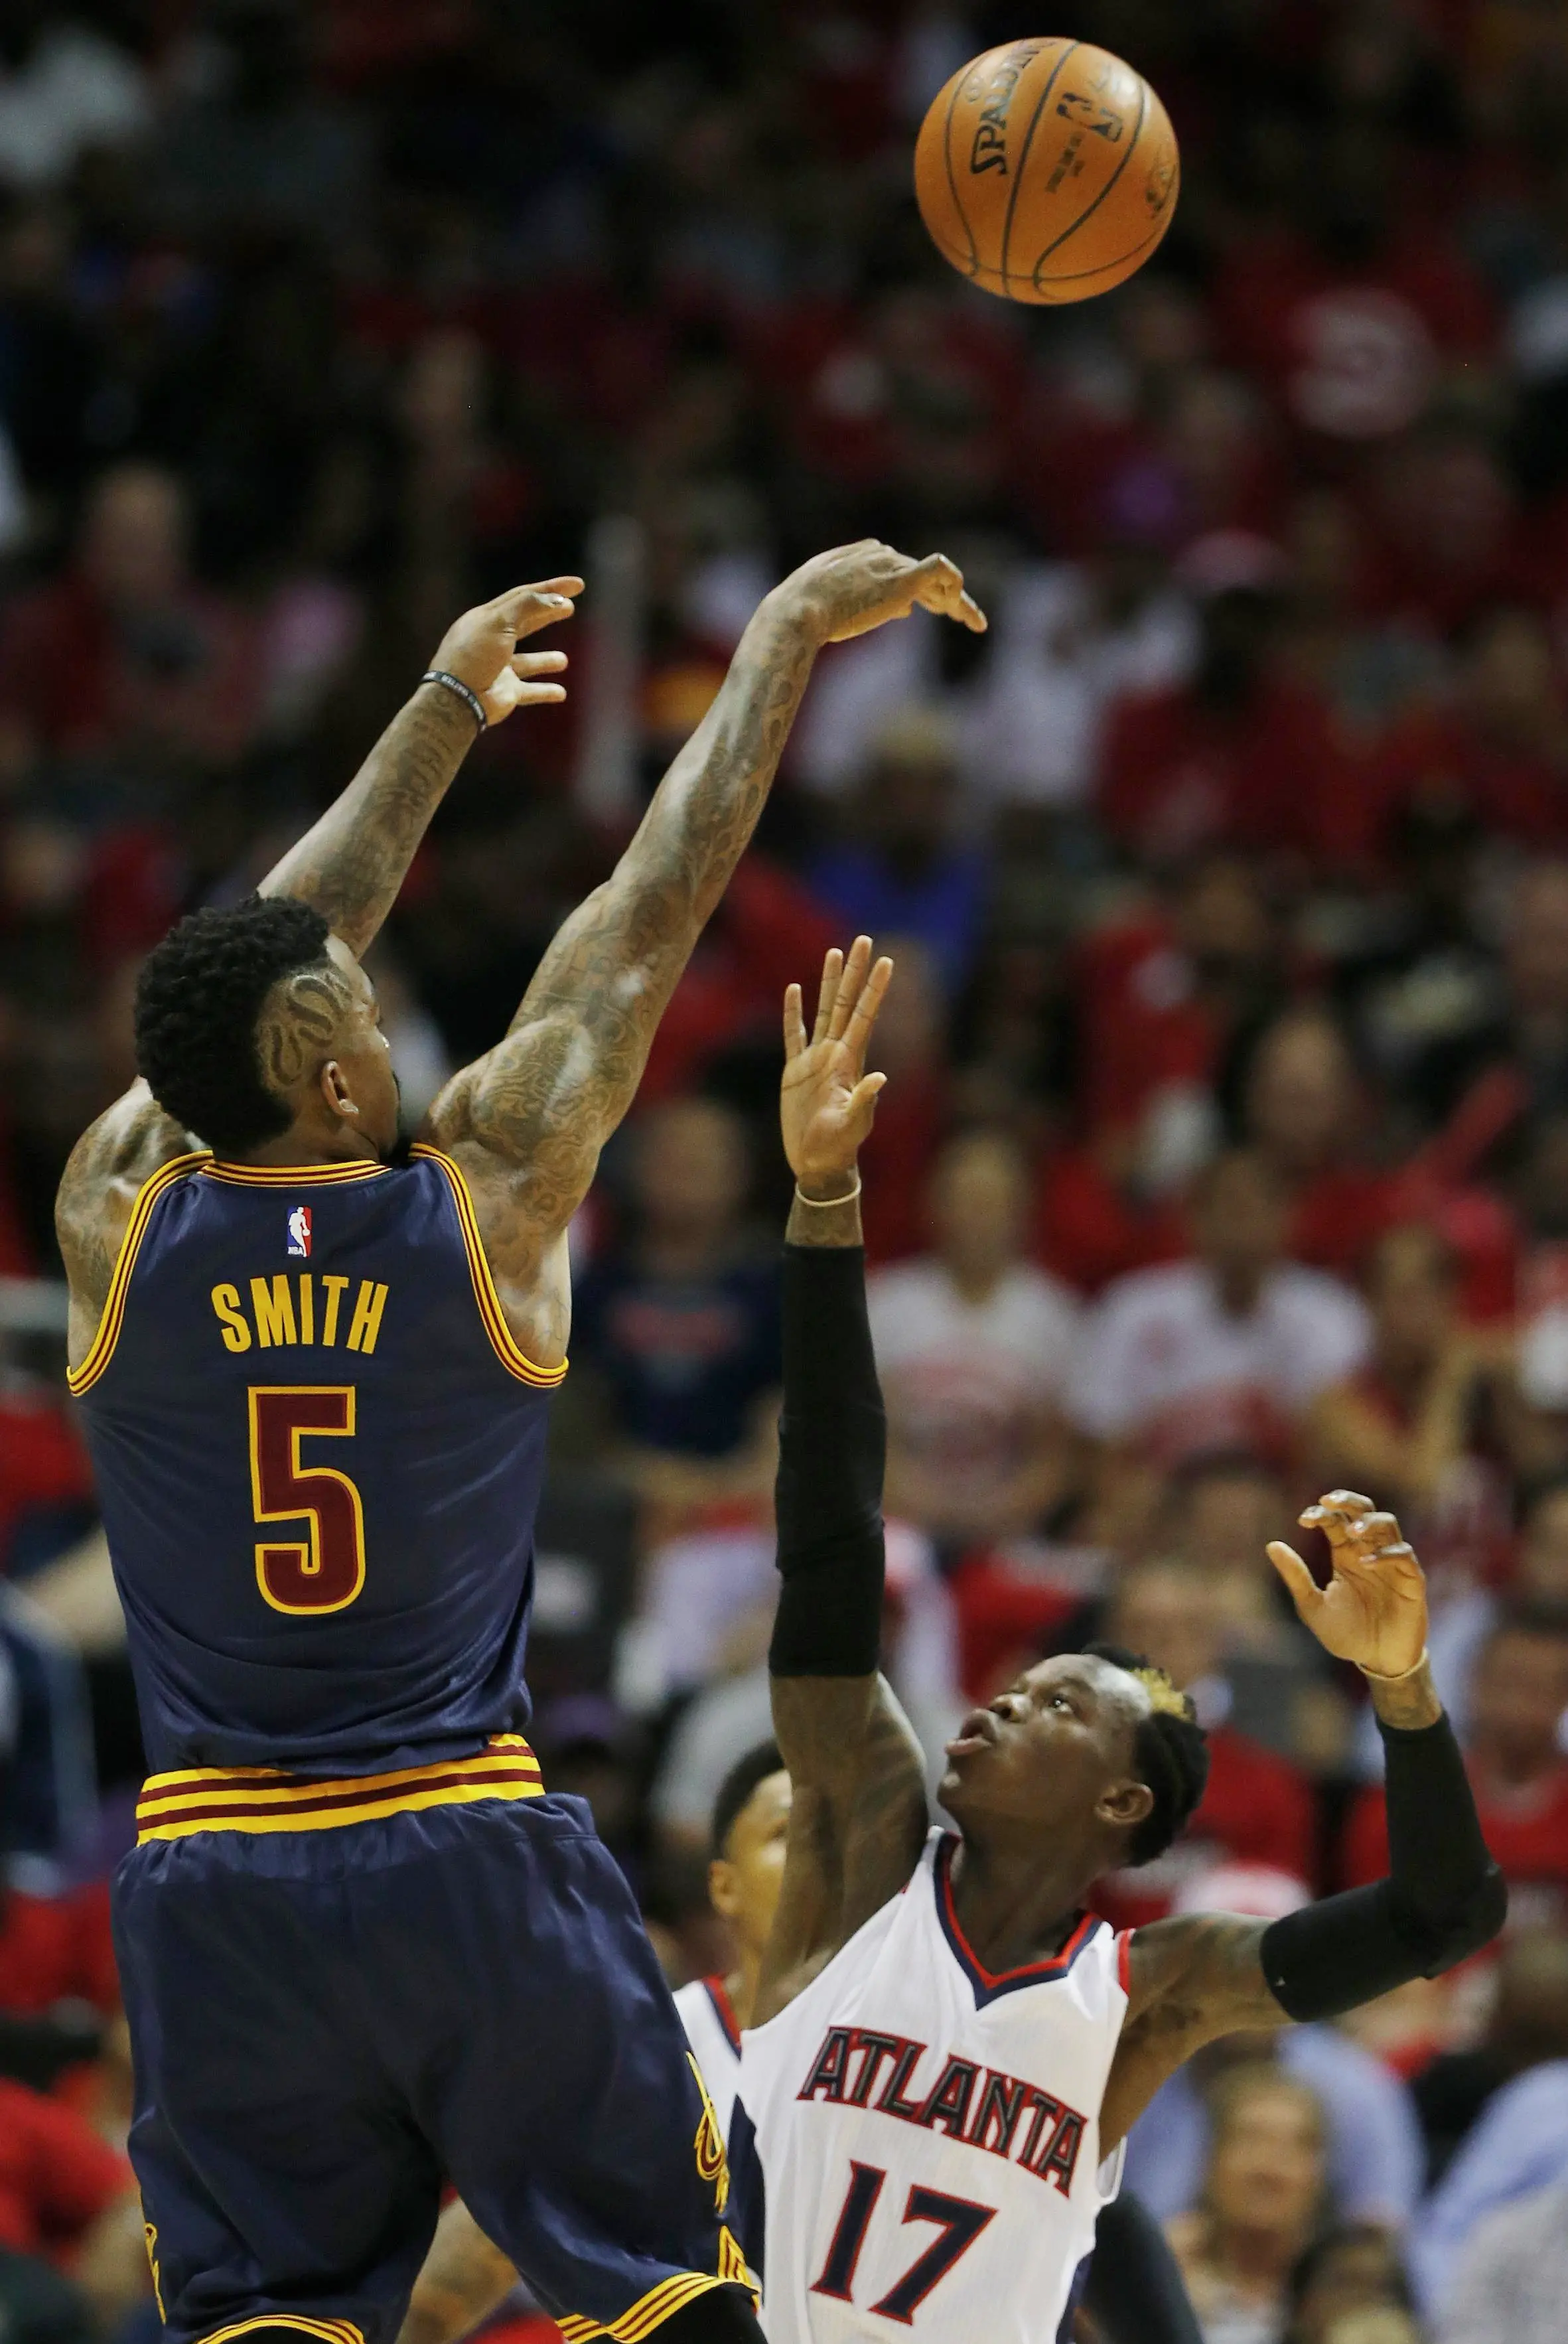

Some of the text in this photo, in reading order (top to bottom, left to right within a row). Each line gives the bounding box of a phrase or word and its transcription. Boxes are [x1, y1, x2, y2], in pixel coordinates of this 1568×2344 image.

[969, 38, 1056, 176] SPALD
[211, 1274, 388, 1354] SMITH
[248, 1386, 366, 1615] 5
[795, 2025, 1089, 2200] ATLANTA
[809, 2159, 999, 2326] 17
